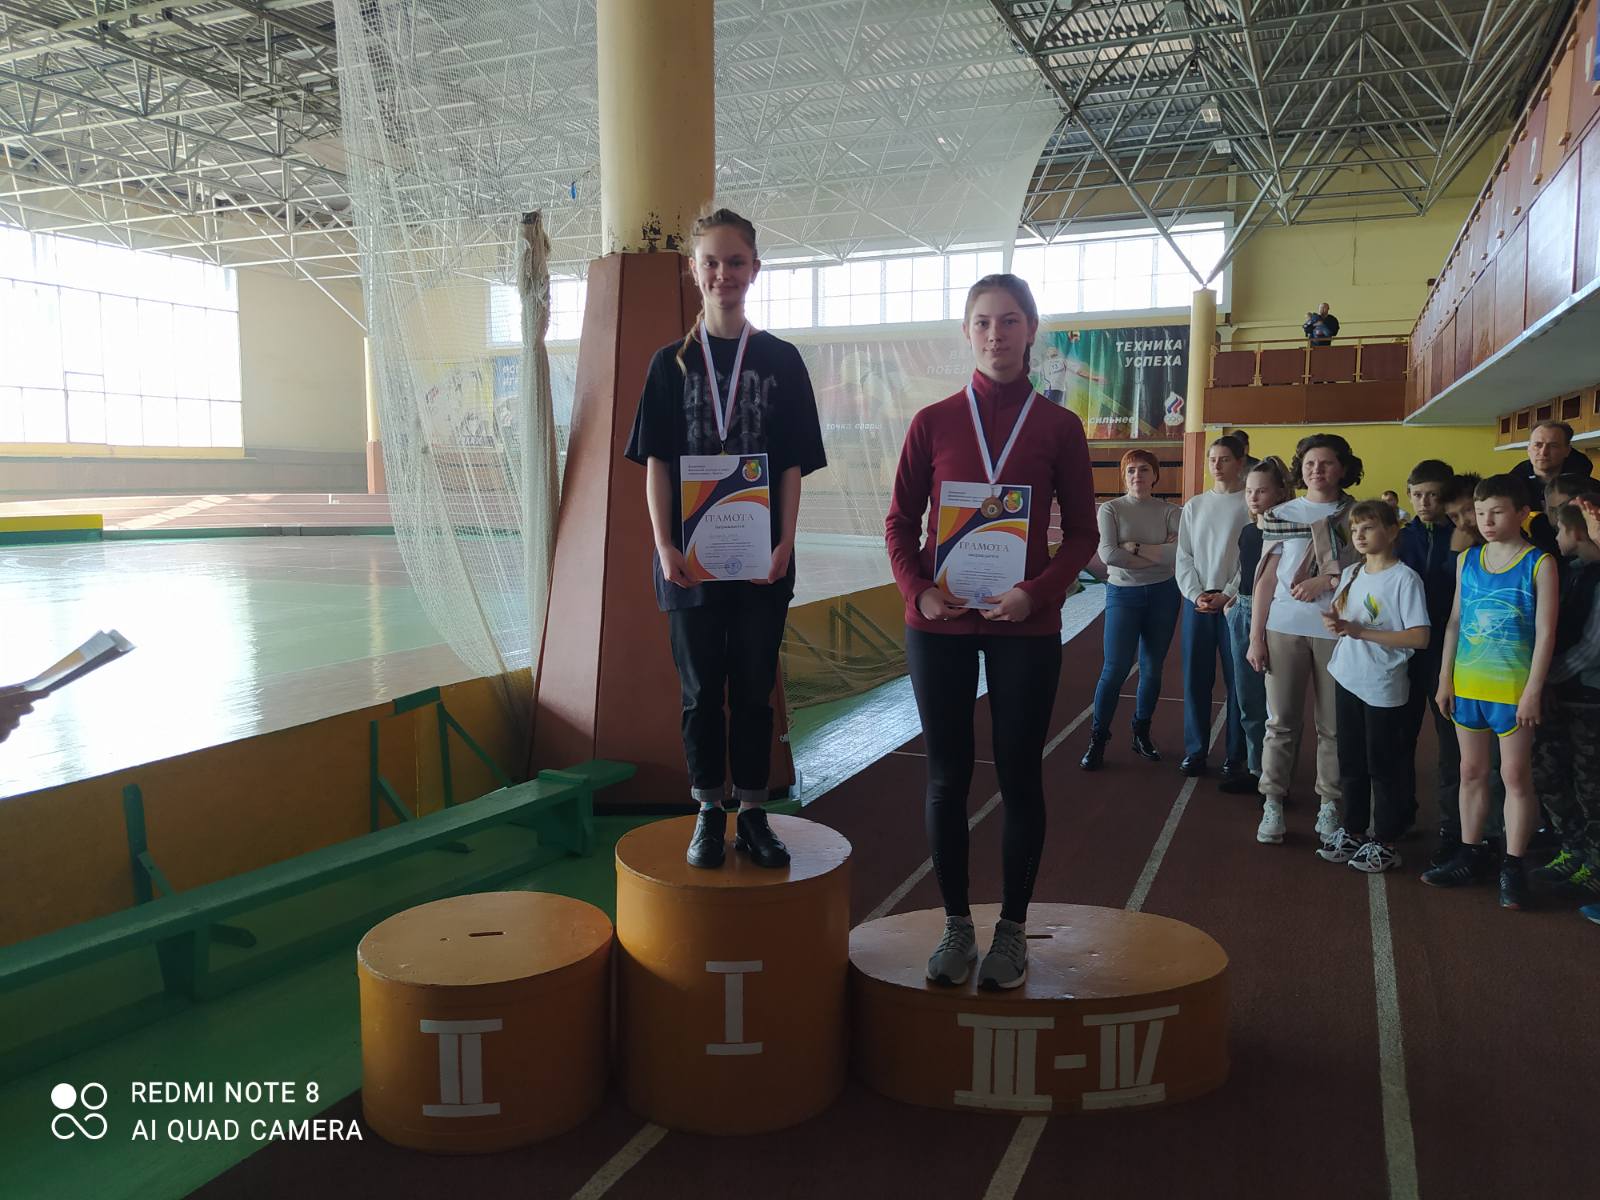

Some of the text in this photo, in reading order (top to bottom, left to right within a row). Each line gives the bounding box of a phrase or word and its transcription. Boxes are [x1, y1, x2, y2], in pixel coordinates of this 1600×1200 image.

[1115, 339, 1183, 353] ТЕХНИКА
[1125, 355, 1182, 368] УСПЕХА
[1088, 416, 1137, 425] сильнее
[704, 513, 754, 523] ГРАМОТА
[959, 541, 1009, 552] ГРАМОТА
[705, 959, 763, 1056] I
[420, 1018, 503, 1117] II
